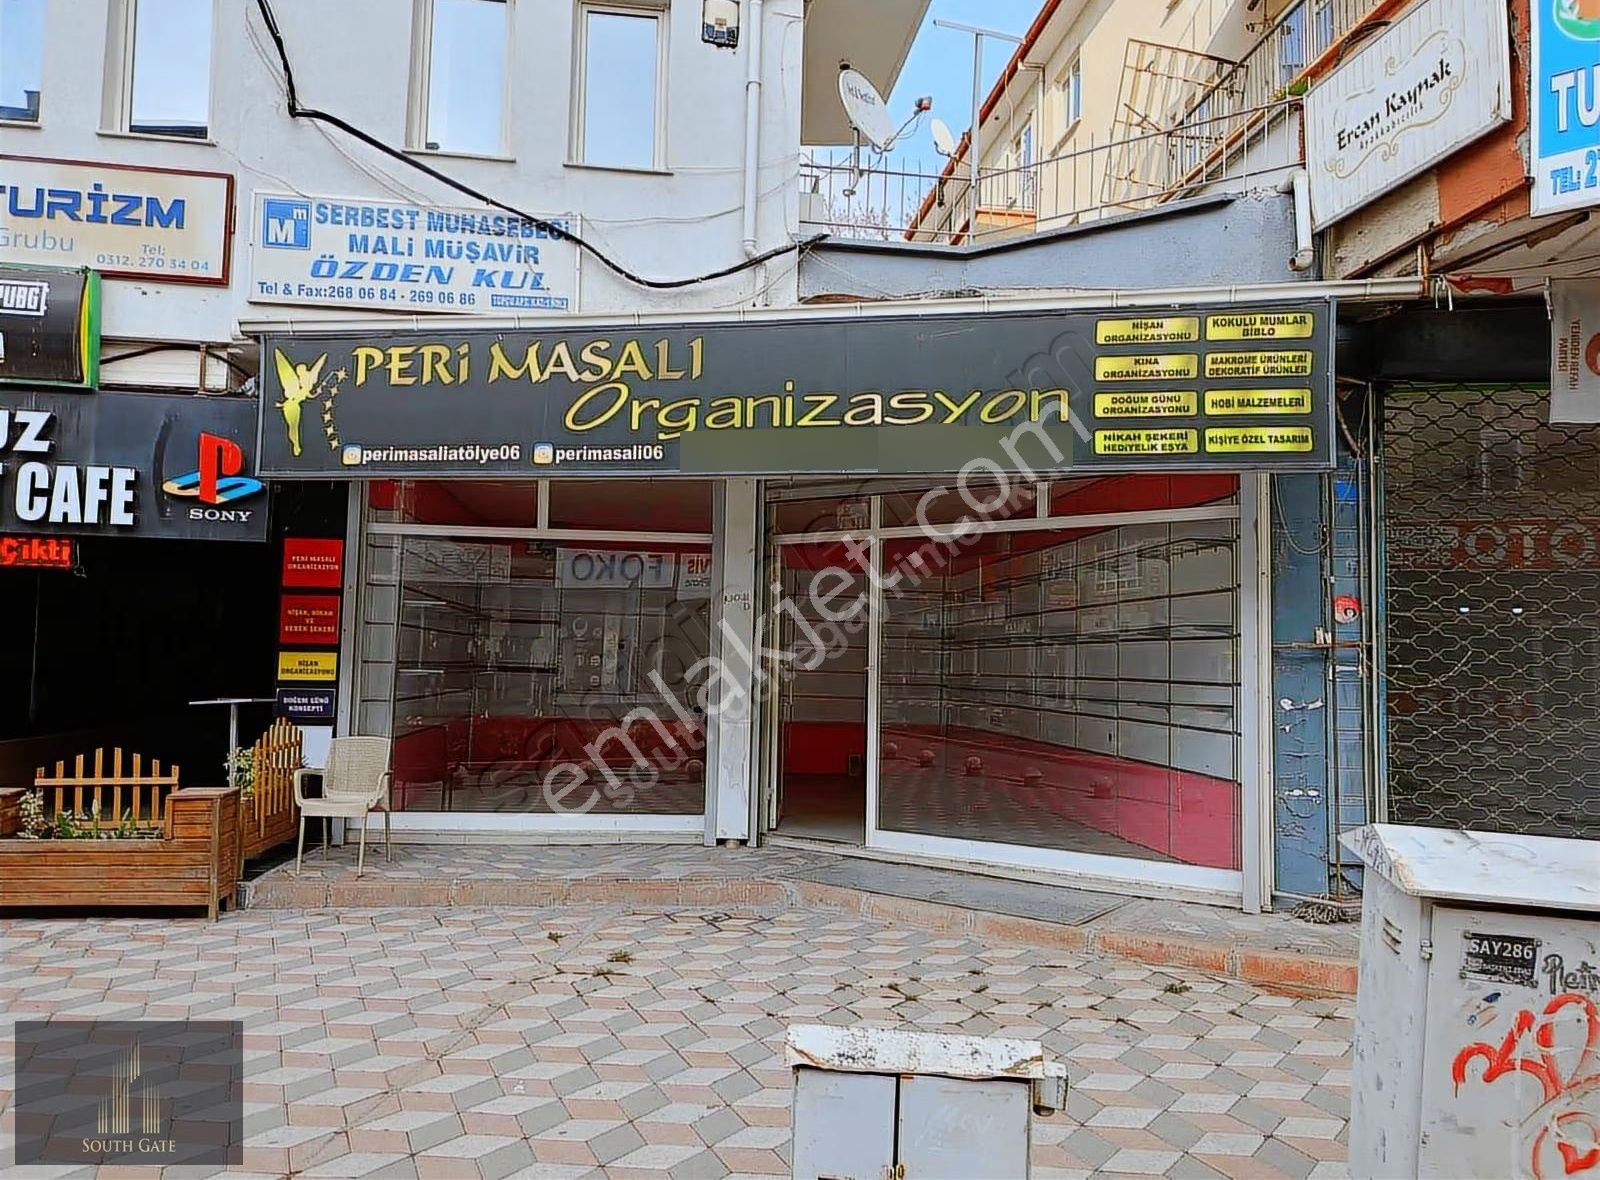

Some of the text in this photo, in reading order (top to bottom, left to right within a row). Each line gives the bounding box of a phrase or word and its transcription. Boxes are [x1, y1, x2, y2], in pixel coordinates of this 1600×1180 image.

[1337, 57, 1452, 151] Ercan Kaynak
[1584, 150, 1600, 189] 2
[0, 183, 186, 230] URİZM
[316, 203, 420, 231] SERBEST
[138, 257, 165, 269] 270
[169, 259, 186, 270] 34
[191, 261, 209, 271] 04
[310, 254, 455, 285] ÖZDEN
[0, 285, 40, 310] UBG
[258, 281, 274, 296] Tel
[282, 284, 293, 296] &
[358, 286, 375, 300] 06
[379, 288, 397, 301] 84
[409, 289, 434, 304] 269
[438, 291, 455, 305] 06
[459, 293, 476, 306] 86
[1212, 314, 1308, 328] KOKULU MUMLAR
[1103, 331, 1192, 343] ORGANİZASYONU
[487, 336, 704, 385] MASALI
[1133, 357, 1160, 366] KINA
[1211, 355, 1257, 366] MAKROME
[1103, 367, 1190, 379] ORGANİZASYONU
[563, 379, 1071, 440] Organizasyon
[1102, 403, 1190, 415] ORGANİZASYONU
[1211, 396, 1235, 409] HOBİ
[1267, 433, 1309, 445] TASARIM
[555, 445, 664, 464] perimasali06
[15, 461, 135, 526] CAFE
[188, 508, 253, 522] SONY
[1469, 938, 1534, 960] SAY286
